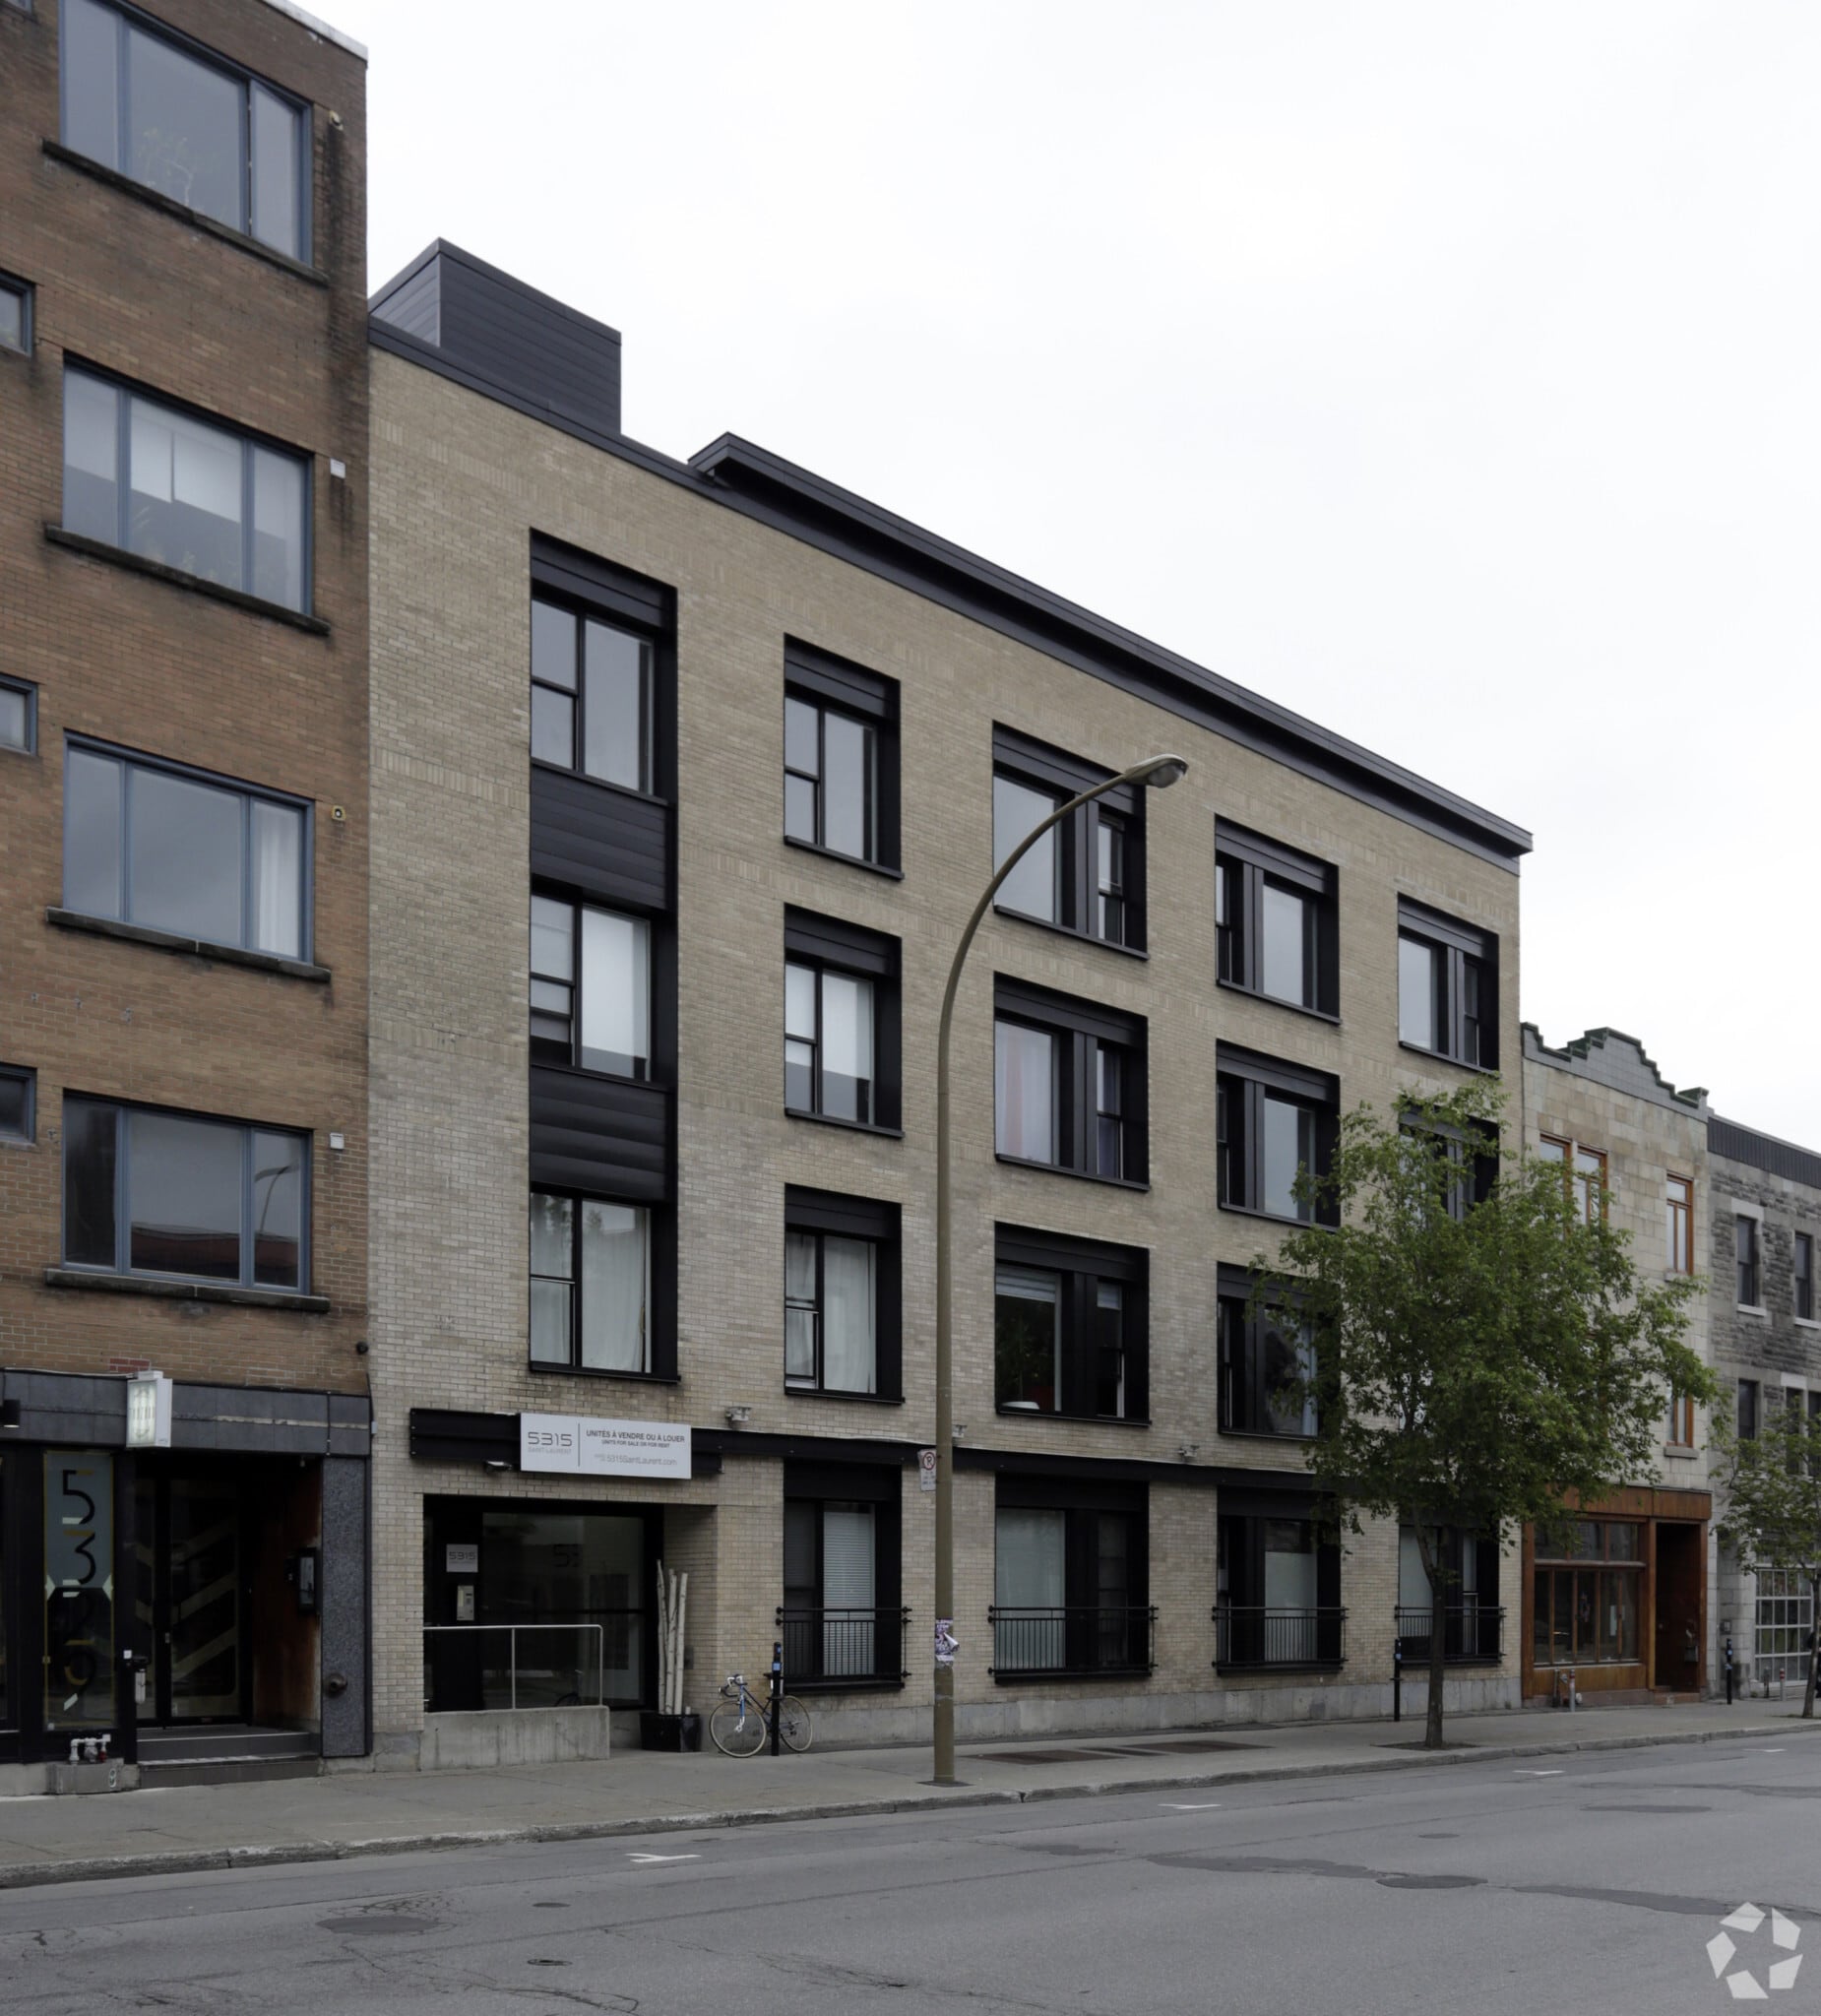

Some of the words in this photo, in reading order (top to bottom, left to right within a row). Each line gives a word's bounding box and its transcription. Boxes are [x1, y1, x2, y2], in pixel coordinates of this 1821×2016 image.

[528, 1431, 573, 1447] 5315
[586, 1429, 611, 1438] UNITÉS
[663, 1434, 685, 1443] LOUER
[449, 1551, 476, 1560] 5315
